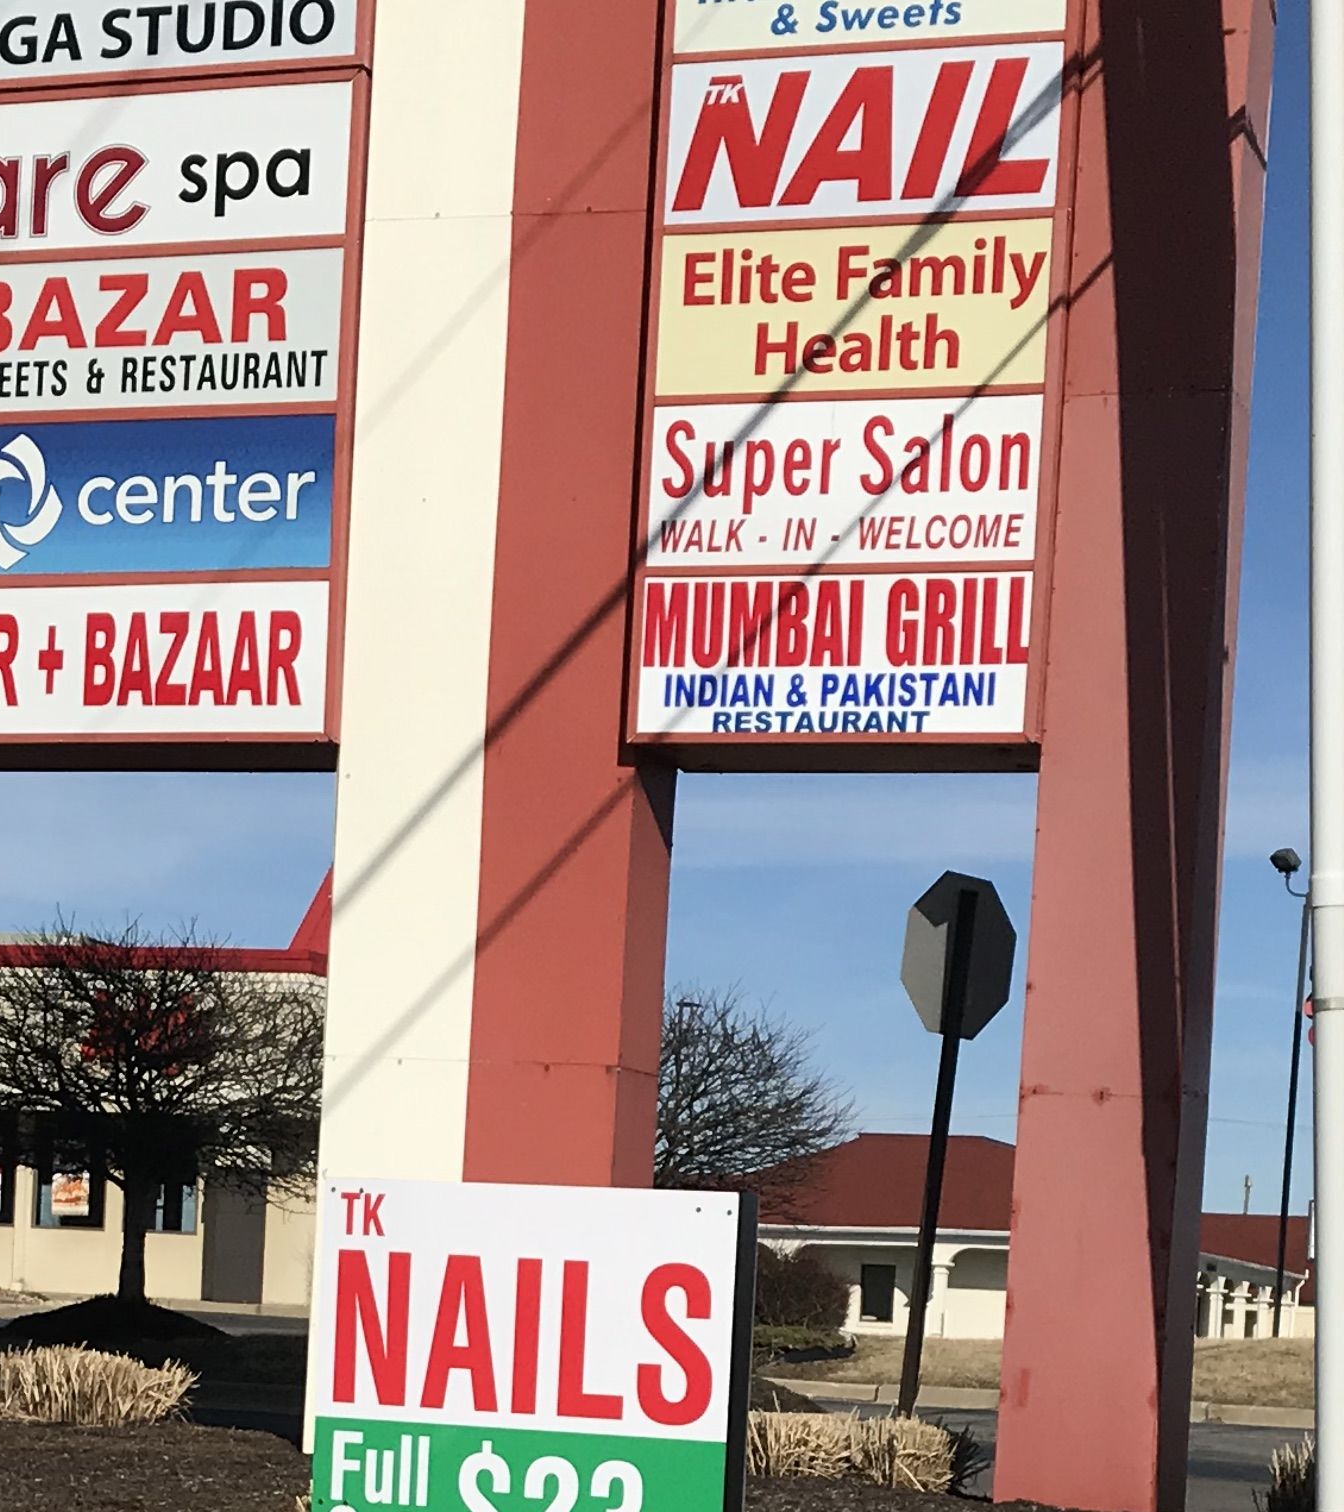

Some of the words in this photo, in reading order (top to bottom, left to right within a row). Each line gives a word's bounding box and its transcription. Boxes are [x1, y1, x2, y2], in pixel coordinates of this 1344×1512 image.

[100, 0, 335, 59] STUDIO
[771, 4, 798, 35] &
[815, 0, 963, 33] Sweets
[705, 84, 744, 105] TK
[672, 57, 1050, 211] NAIL
[179, 147, 311, 217] spa
[683, 248, 815, 306] Elite
[836, 236, 1047, 310] Family
[87, 364, 104, 394] &
[121, 350, 329, 393] RESTAURANT
[754, 312, 960, 376] Health
[78, 460, 316, 525] center
[662, 419, 841, 514] Super
[859, 413, 1031, 496] Salon
[659, 518, 746, 553] WALK
[782, 518, 817, 551] IN
[859, 513, 1025, 550] WELCOME
[643, 580, 865, 668] MUMBAI
[885, 576, 1030, 667] GRILL
[38, 625, 63, 694] +
[83, 610, 302, 706] BAZAAR
[663, 674, 775, 707] INDIAN
[786, 675, 807, 706] &
[821, 672, 996, 706] PAKISTANI
[712, 711, 931, 733] RESTAURANT
[341, 1192, 386, 1237] TK
[332, 1248, 713, 1426] NAILS
[331, 1430, 431, 1507] Full
